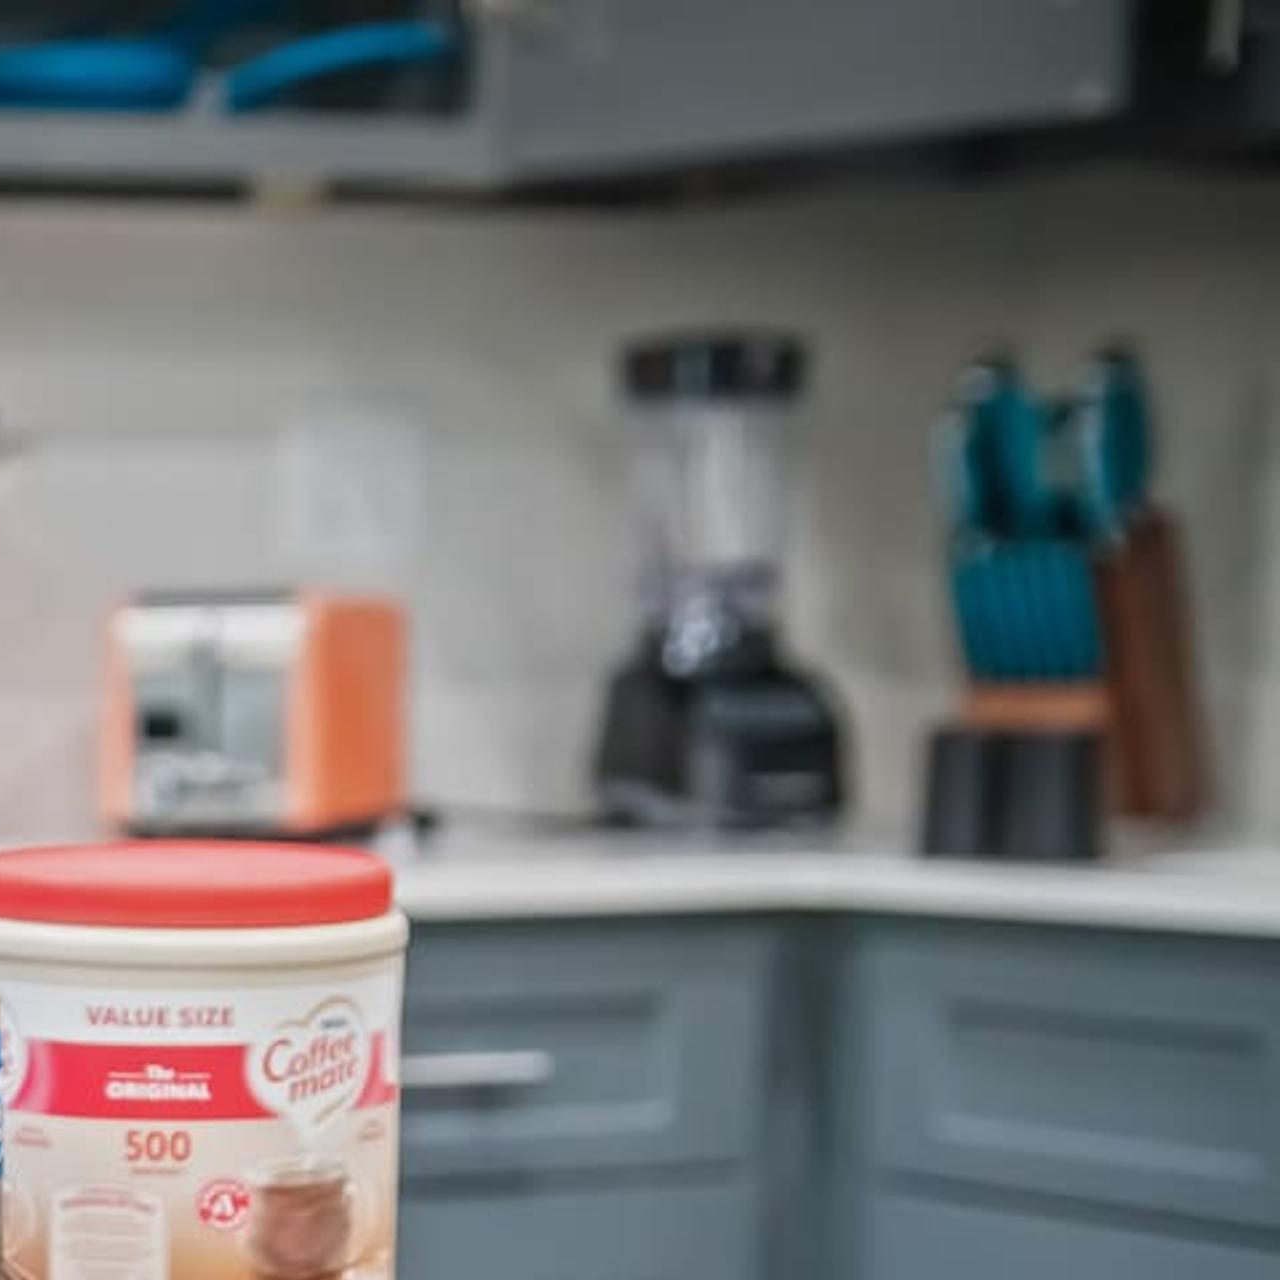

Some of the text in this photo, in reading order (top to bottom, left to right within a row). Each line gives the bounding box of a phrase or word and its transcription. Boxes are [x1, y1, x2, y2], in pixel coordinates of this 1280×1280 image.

[86, 1004, 235, 1028] VALUE SIZE
[104, 1080, 212, 1101] ORIGINAL
[126, 1130, 193, 1162] 500
